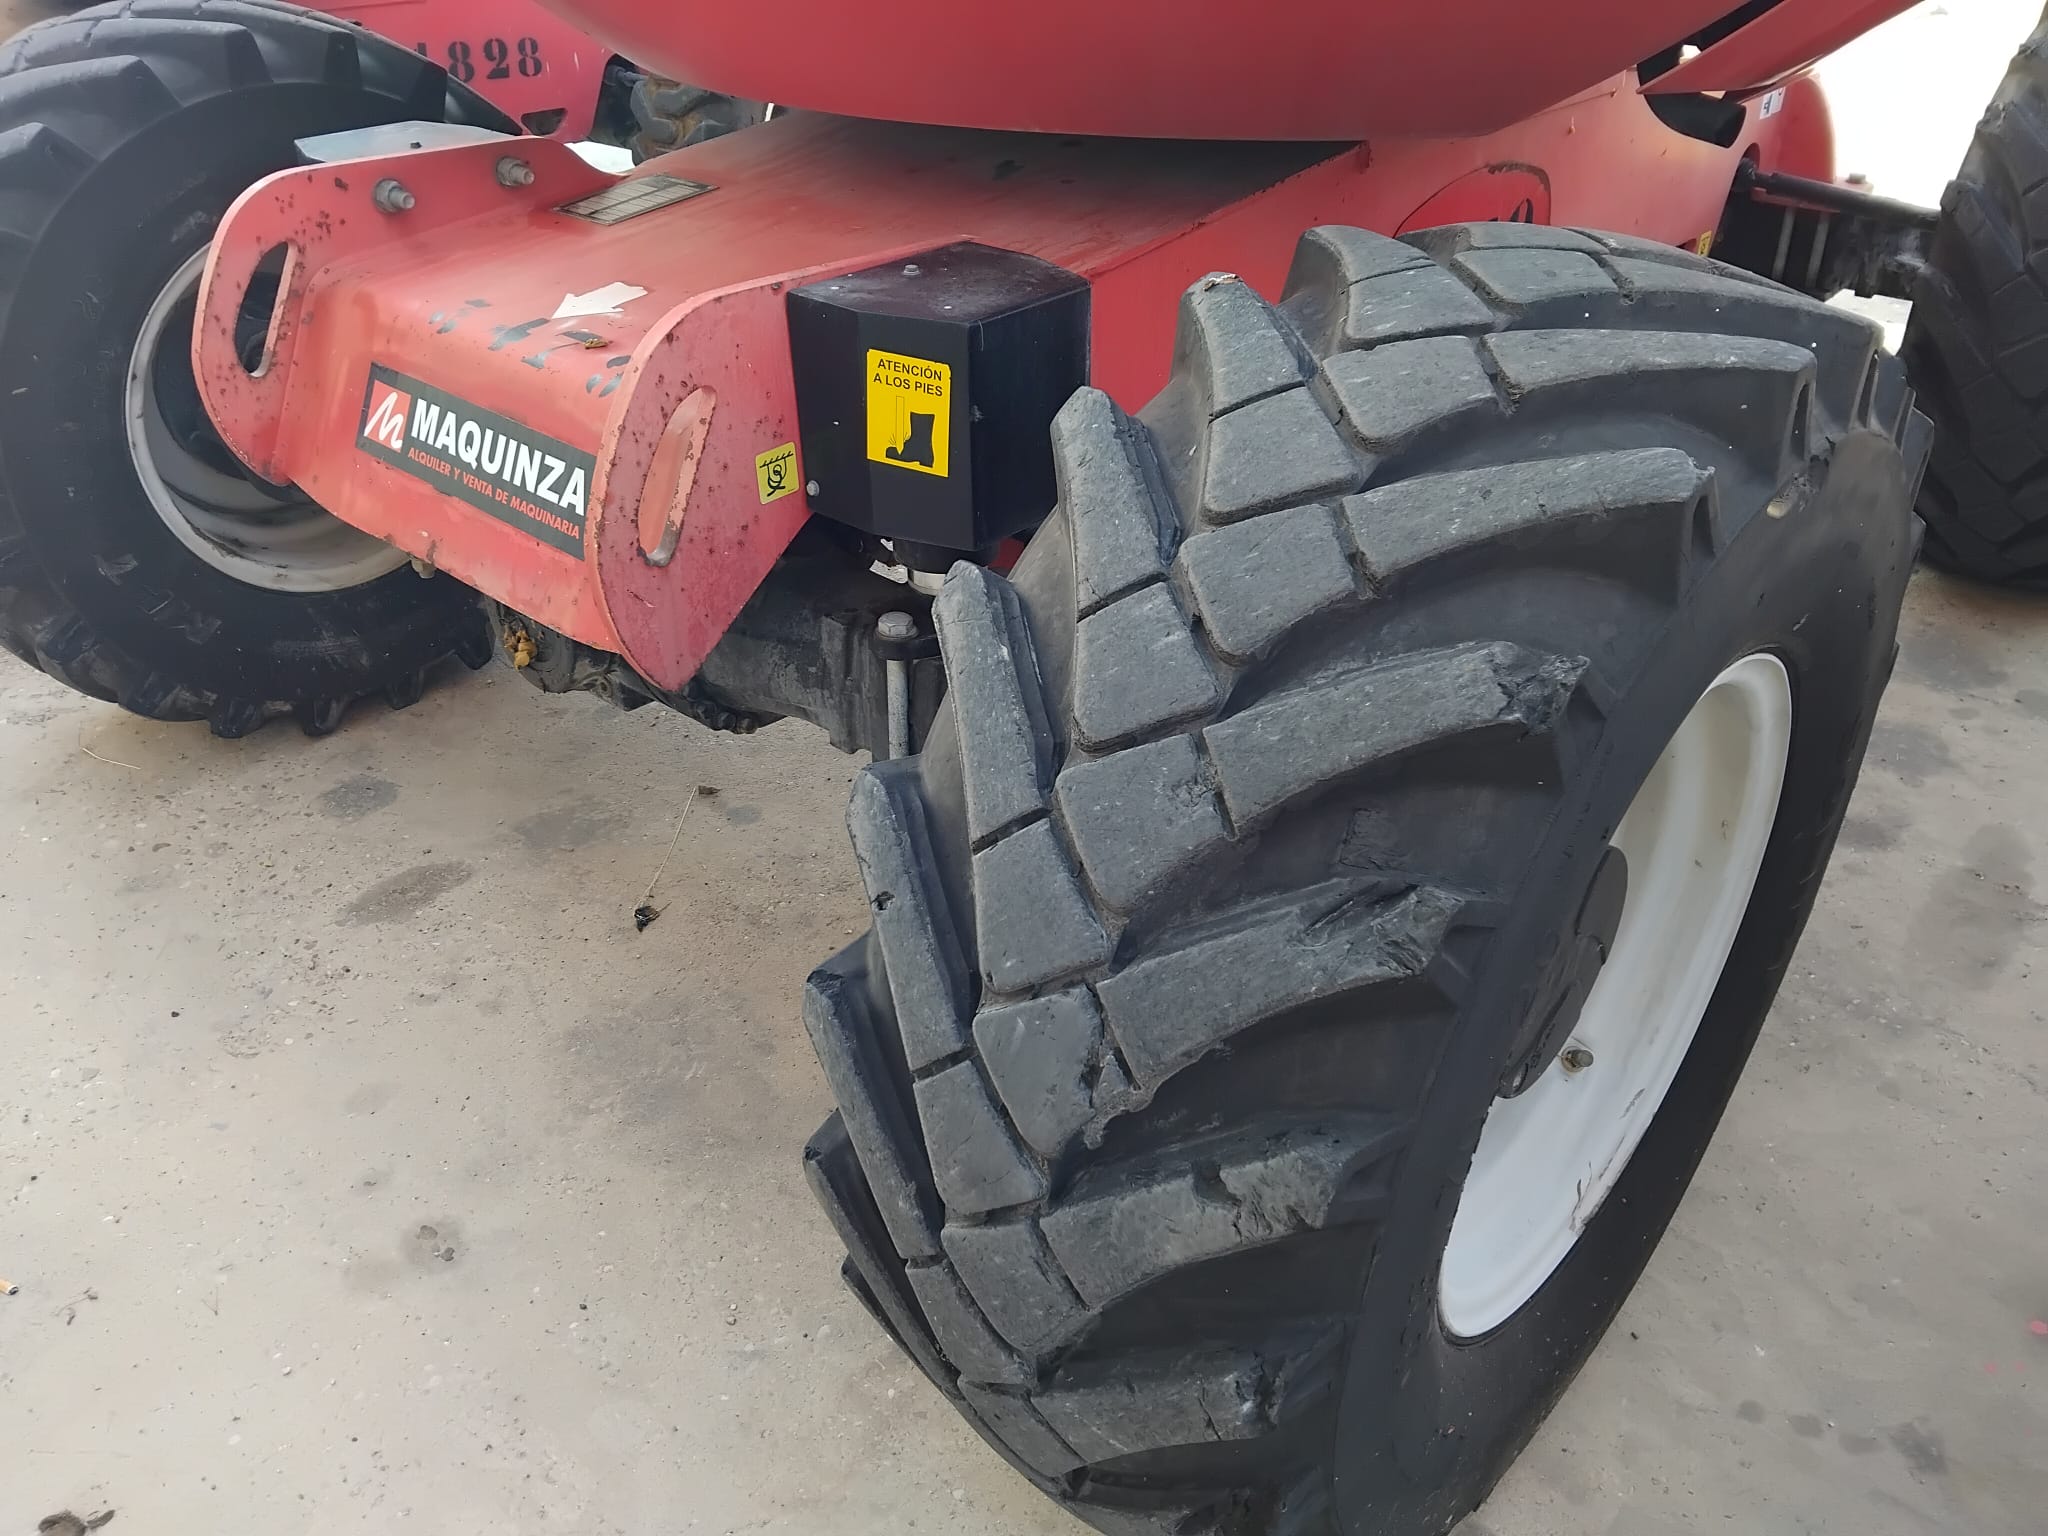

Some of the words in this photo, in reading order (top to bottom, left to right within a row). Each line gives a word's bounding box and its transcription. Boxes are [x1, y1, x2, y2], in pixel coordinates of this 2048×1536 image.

[873, 372, 882, 384] A
[885, 374, 910, 390] LOS
[914, 381, 943, 397] PIES
[877, 358, 942, 381] ATENCIÓN
[411, 398, 585, 516] MAQUINZA
[407, 447, 451, 476] ALQUILER
[454, 467, 461, 480] Y
[463, 471, 493, 497] VENTA
[495, 488, 509, 505] DE
[510, 495, 580, 540] MAQUINARIA
